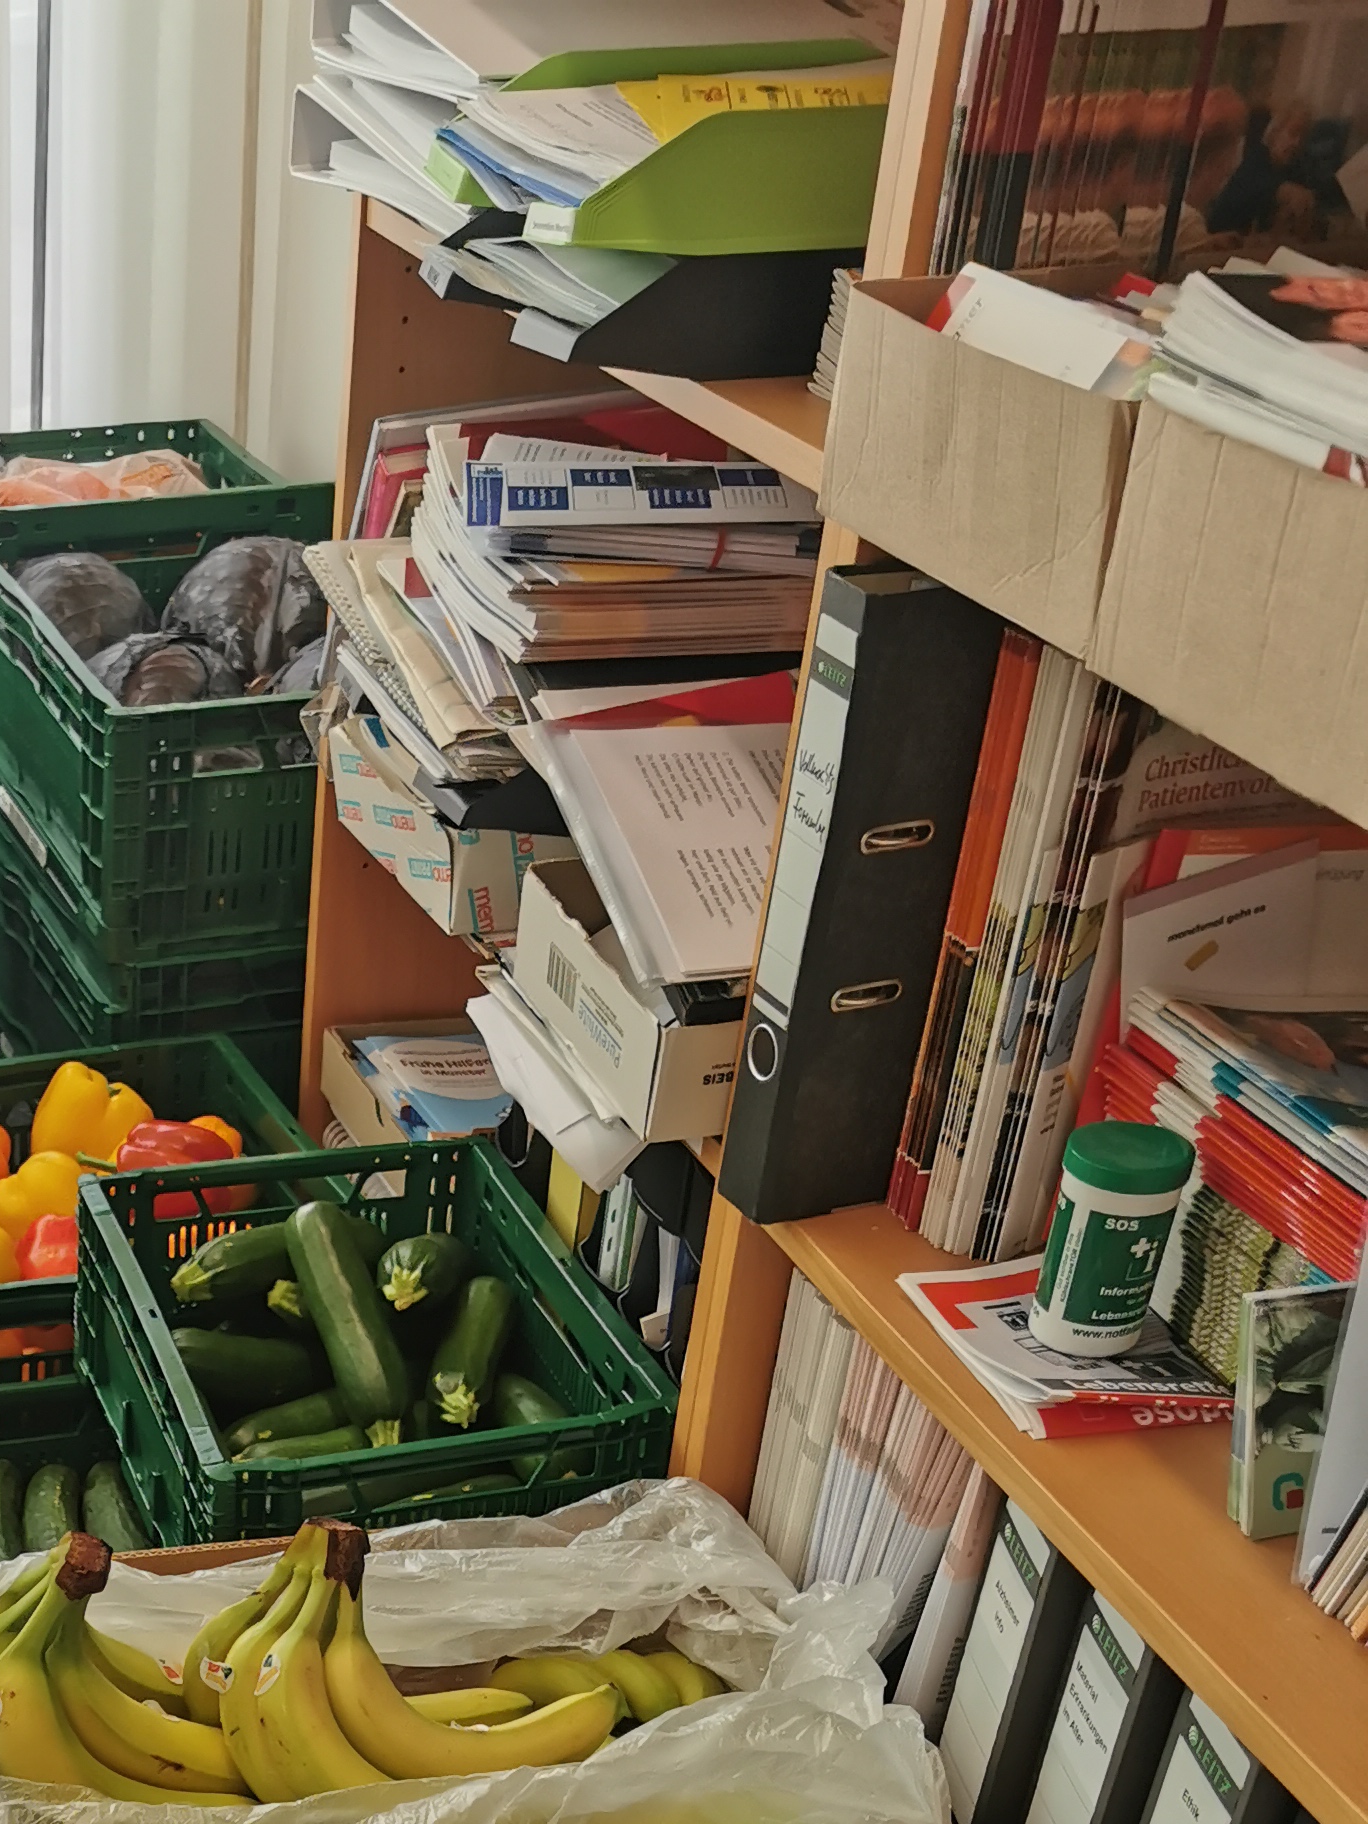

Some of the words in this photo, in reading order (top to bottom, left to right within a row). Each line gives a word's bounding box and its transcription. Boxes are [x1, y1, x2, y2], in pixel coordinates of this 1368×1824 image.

[824, 664, 847, 688] LEITZ
[1144, 746, 1243, 782] Christlic
[1138, 776, 1277, 812] Patientenvor
[1226, 907, 1251, 925] geht
[1254, 904, 1266, 914] es
[578, 1005, 621, 1070] PureWhite
[1104, 1217, 1140, 1232] SOS
[1009, 1535, 1036, 1581] LEITZ
[995, 1580, 1021, 1627] Alzheimer
[1100, 1625, 1130, 1681] LEITZ
[1076, 1660, 1099, 1703] Material
[1062, 1704, 1071, 1724] im
[1068, 1719, 1085, 1746] Alter
[1068, 1683, 1109, 1754] Erkrankungen
[1196, 1738, 1232, 1795] LEITZ
[1182, 1788, 1200, 1822] Ethik
